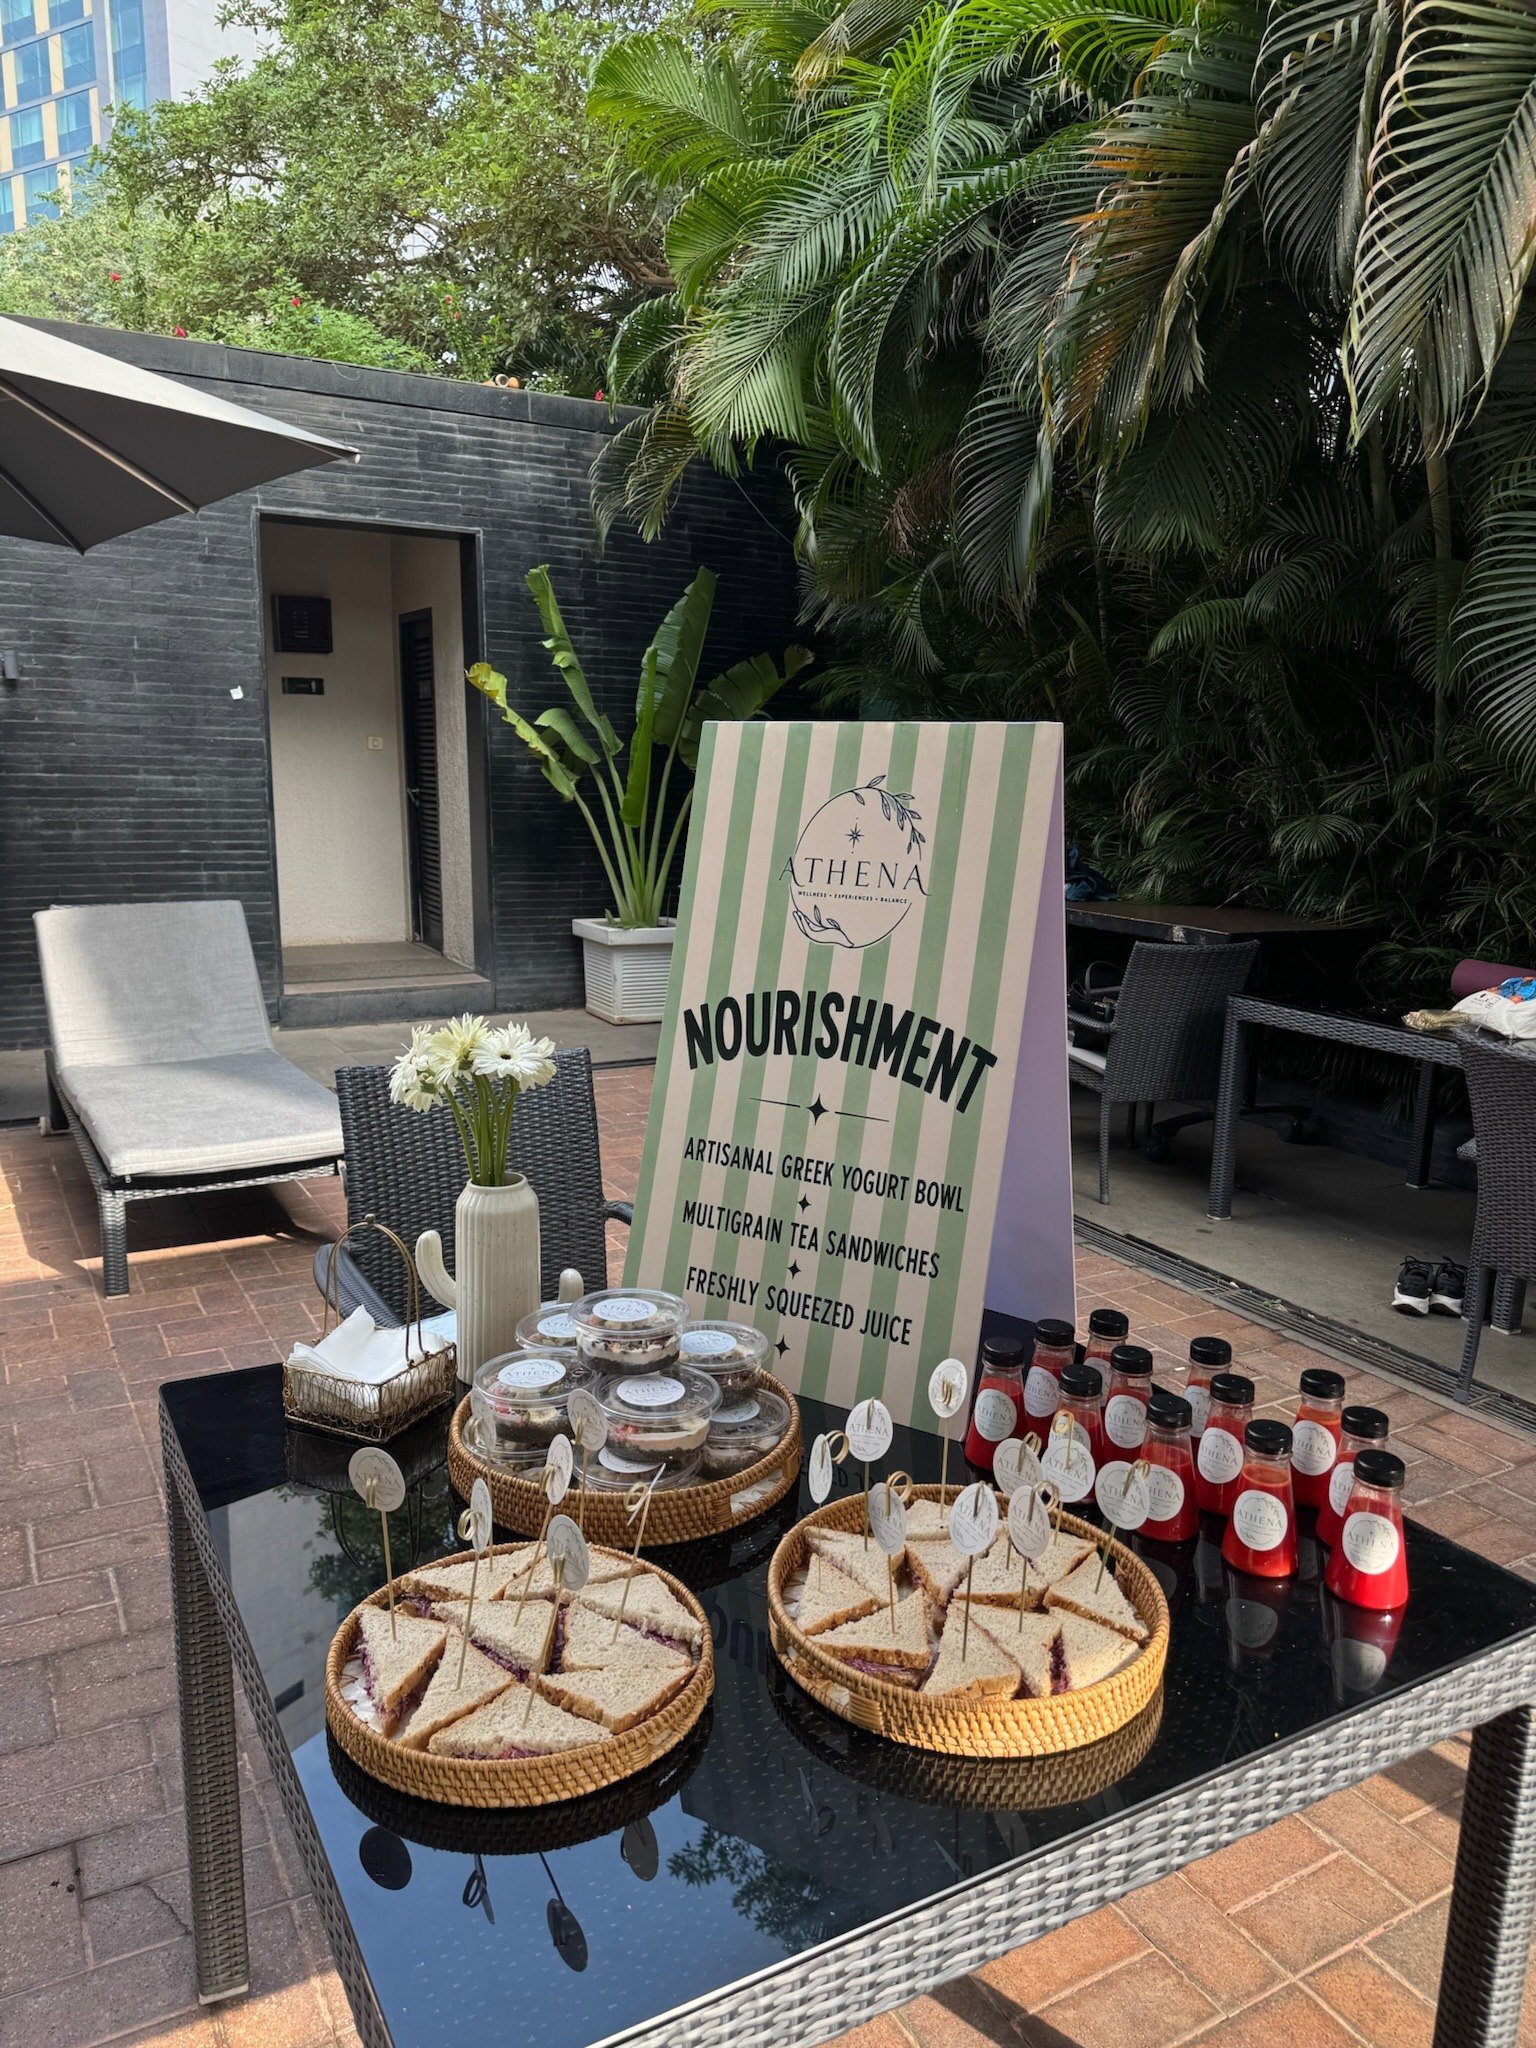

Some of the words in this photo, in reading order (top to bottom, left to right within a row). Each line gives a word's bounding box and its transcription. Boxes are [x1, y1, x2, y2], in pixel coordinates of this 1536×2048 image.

[779, 856, 933, 896] ATHENA
[834, 894, 874, 902] EXPERIENCES
[683, 990, 998, 1114] NOURISHMENT
[684, 1137, 773, 1176] ARTISANAL
[781, 1154, 835, 1187] GREEK
[842, 1165, 910, 1201] YOGURT
[914, 1180, 965, 1213] BOWL
[682, 1200, 783, 1244] MULTIGRAIN
[790, 1222, 819, 1252] TEA
[825, 1230, 940, 1279] SANDWICHES
[686, 1266, 760, 1306] FRESHLY
[765, 1285, 855, 1331] SQUEEZED
[859, 1309, 913, 1346] JUICE
[505, 1368, 561, 1378] ATHENA
[624, 1384, 681, 1396] ATHENA
[977, 1405, 1015, 1425] ATHENA
[848, 1422, 890, 1438] ATHENA
[1237, 1509, 1284, 1530] ATHENA
[1347, 1530, 1397, 1552] ATHENA
